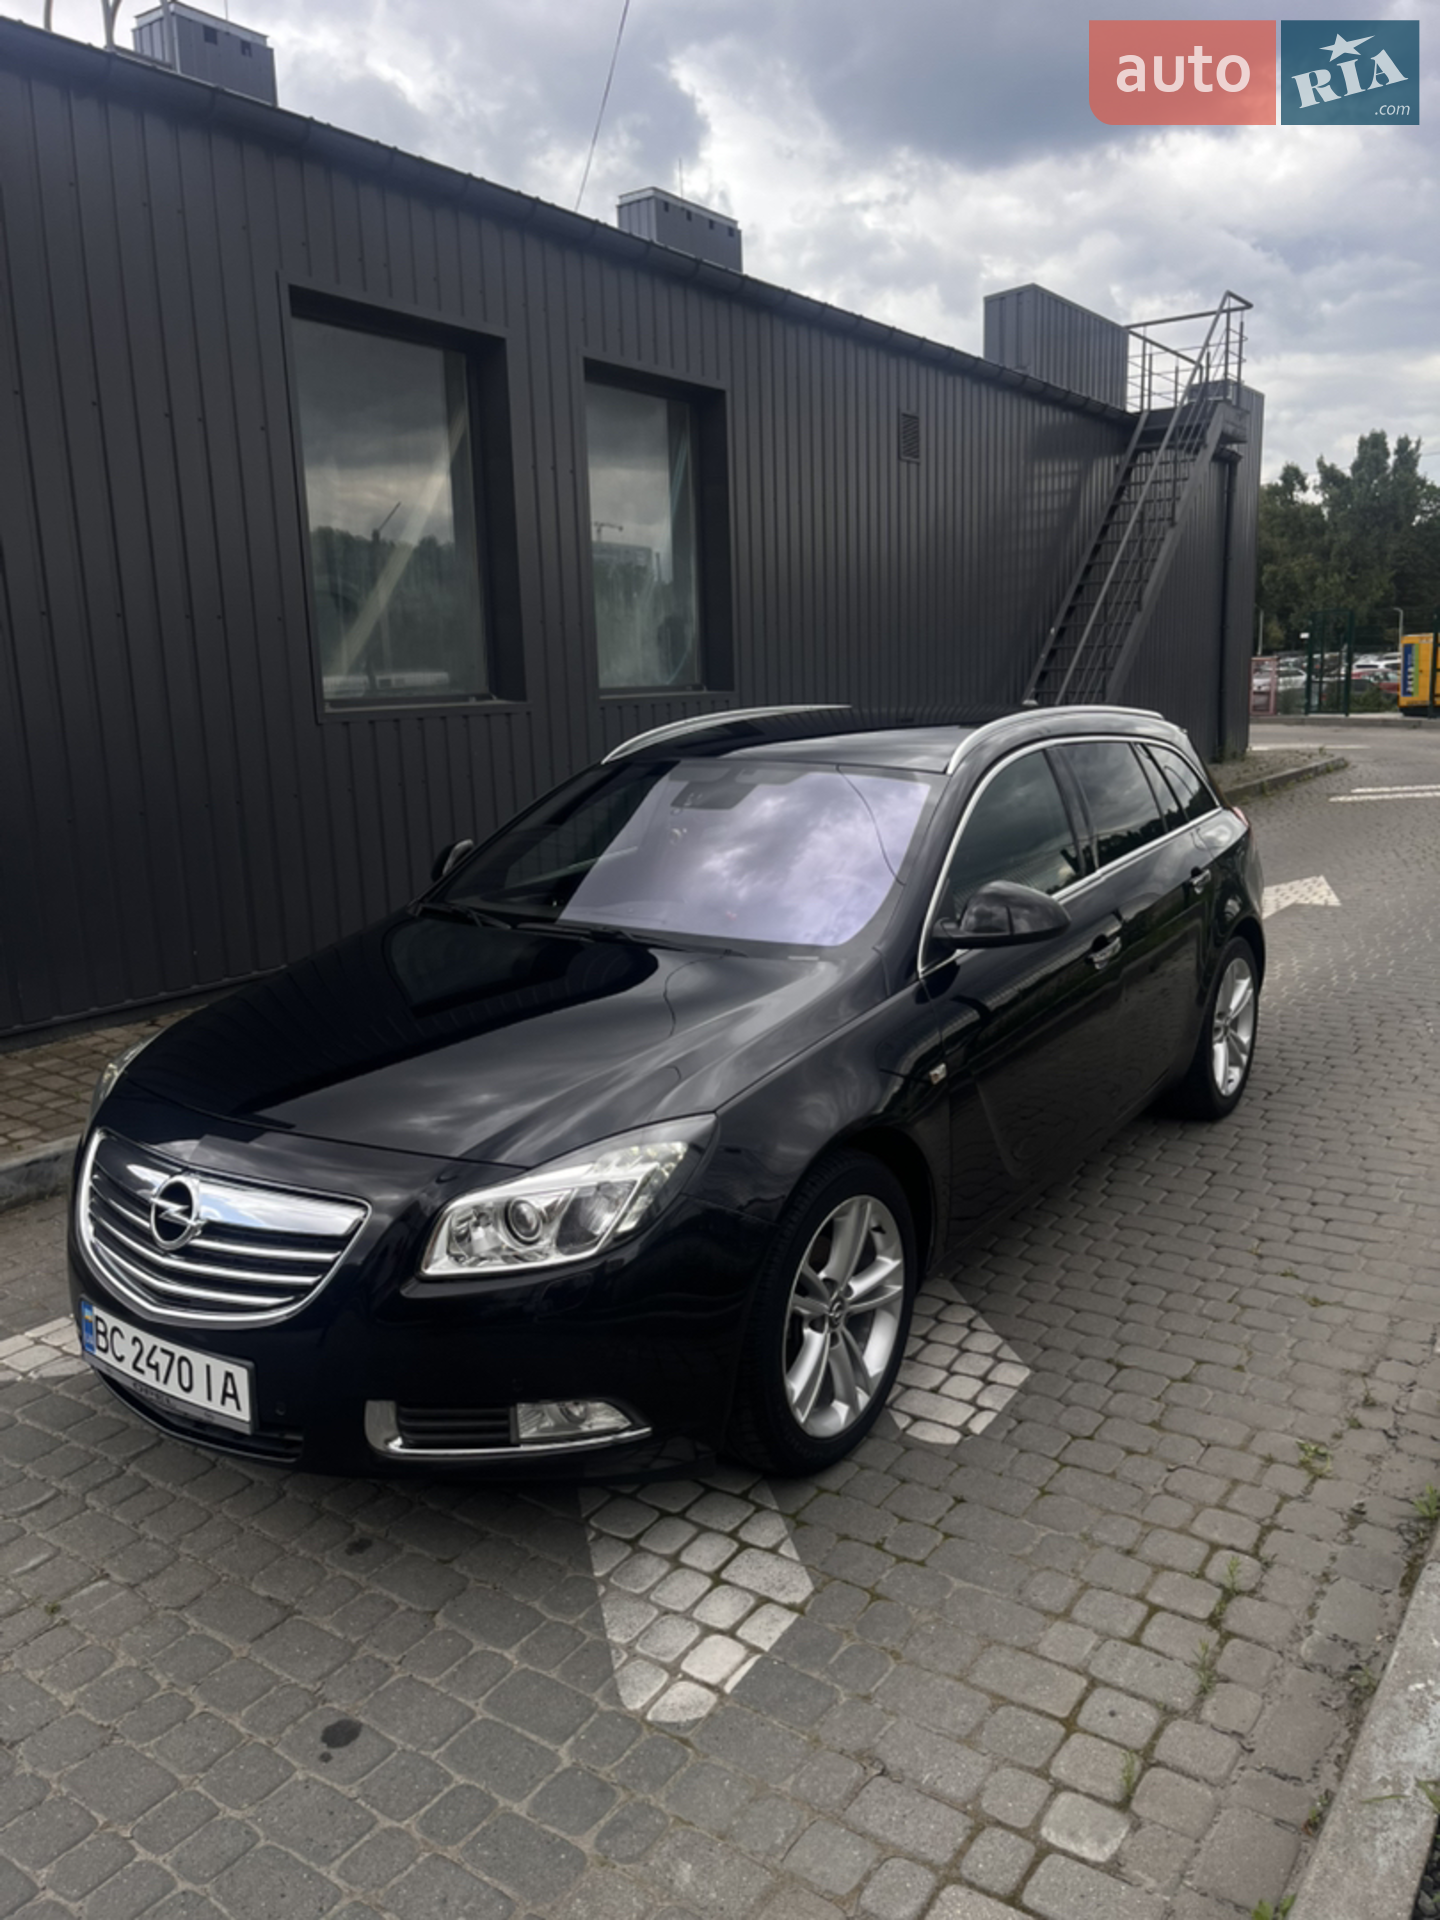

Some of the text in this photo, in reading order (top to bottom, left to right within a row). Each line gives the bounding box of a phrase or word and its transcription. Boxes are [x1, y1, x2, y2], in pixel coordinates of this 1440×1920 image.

[95, 1315, 125, 1363] BC
[131, 1336, 194, 1394] 2470
[206, 1363, 242, 1411] IA
